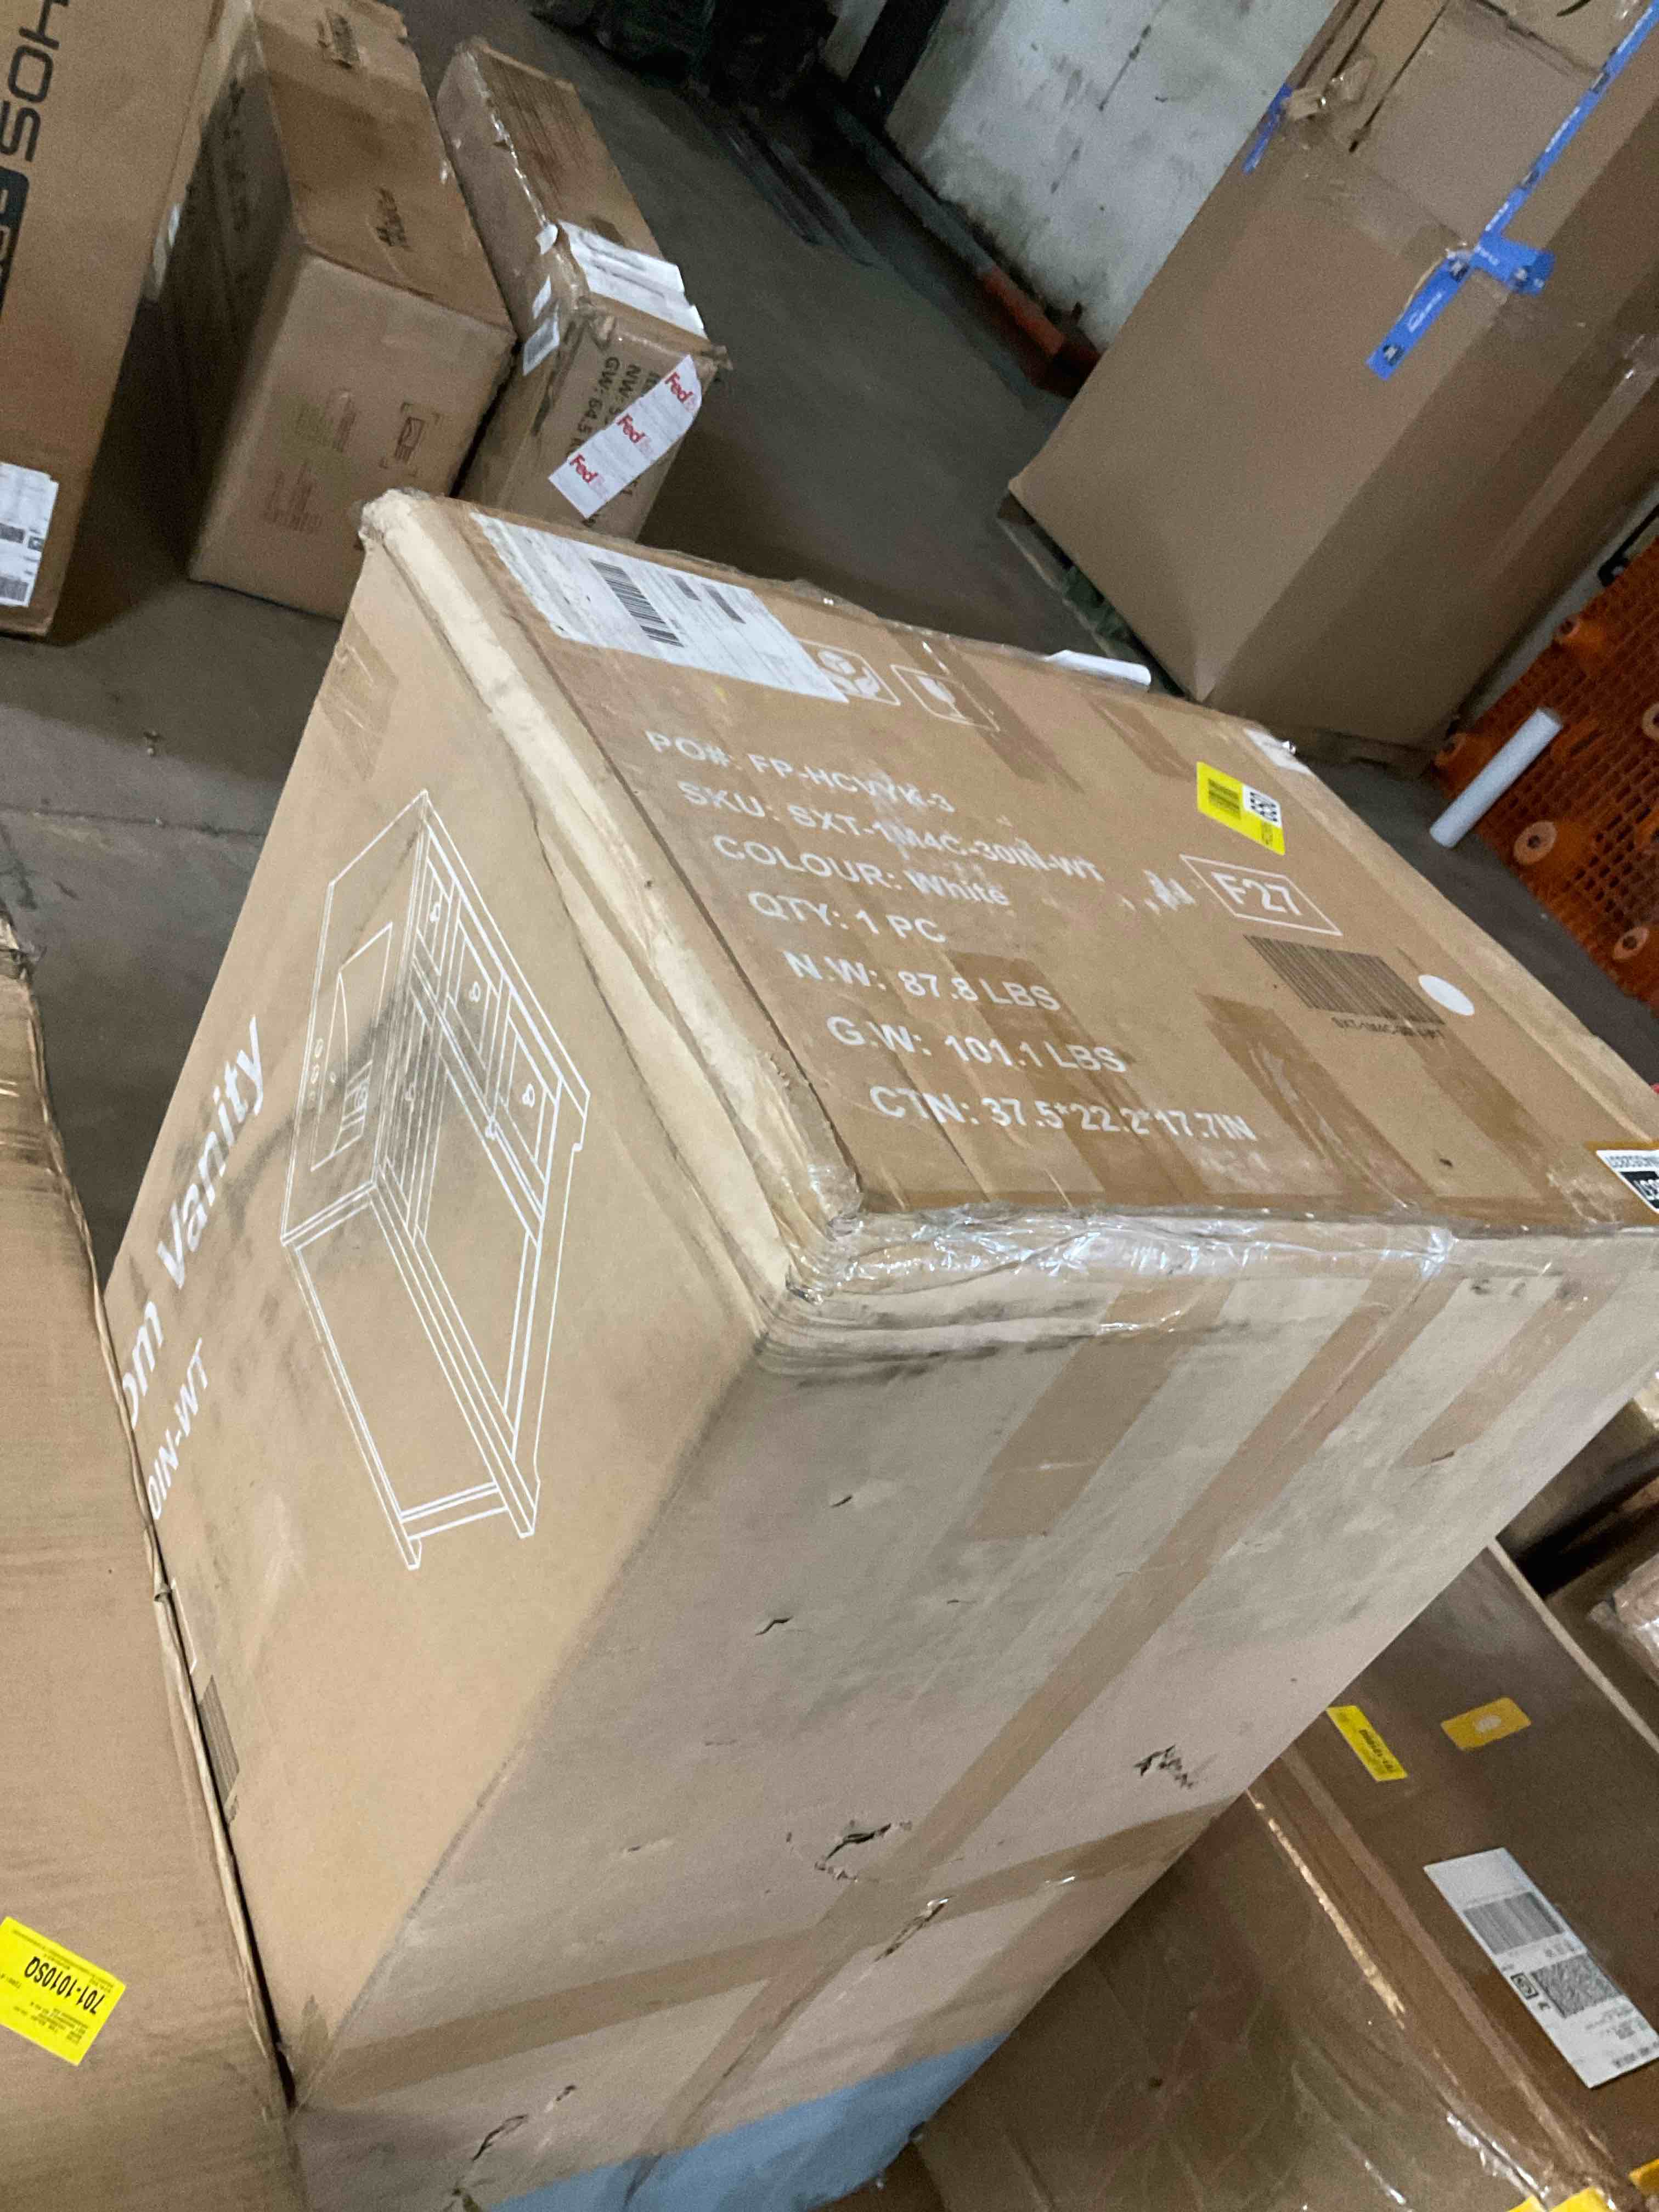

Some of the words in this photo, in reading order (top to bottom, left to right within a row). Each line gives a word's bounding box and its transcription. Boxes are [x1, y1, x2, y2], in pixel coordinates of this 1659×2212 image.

[676, 781, 781, 822] SKU:
[713, 834, 902, 890] COLOUR:
[903, 868, 1011, 906] White
[1211, 871, 1302, 915] F27
[747, 891, 850, 929] QTY:
[855, 909, 879, 934] 1
[886, 913, 946, 944] PC
[898, 970, 979, 1002] 87.8
[980, 977, 1062, 1011] LBS
[944, 1035, 1043, 1072] 101.1
[1044, 1041, 1127, 1073] LBS
[869, 1085, 980, 1126] CTN:
[157, 1014, 263, 1289] Vanity
